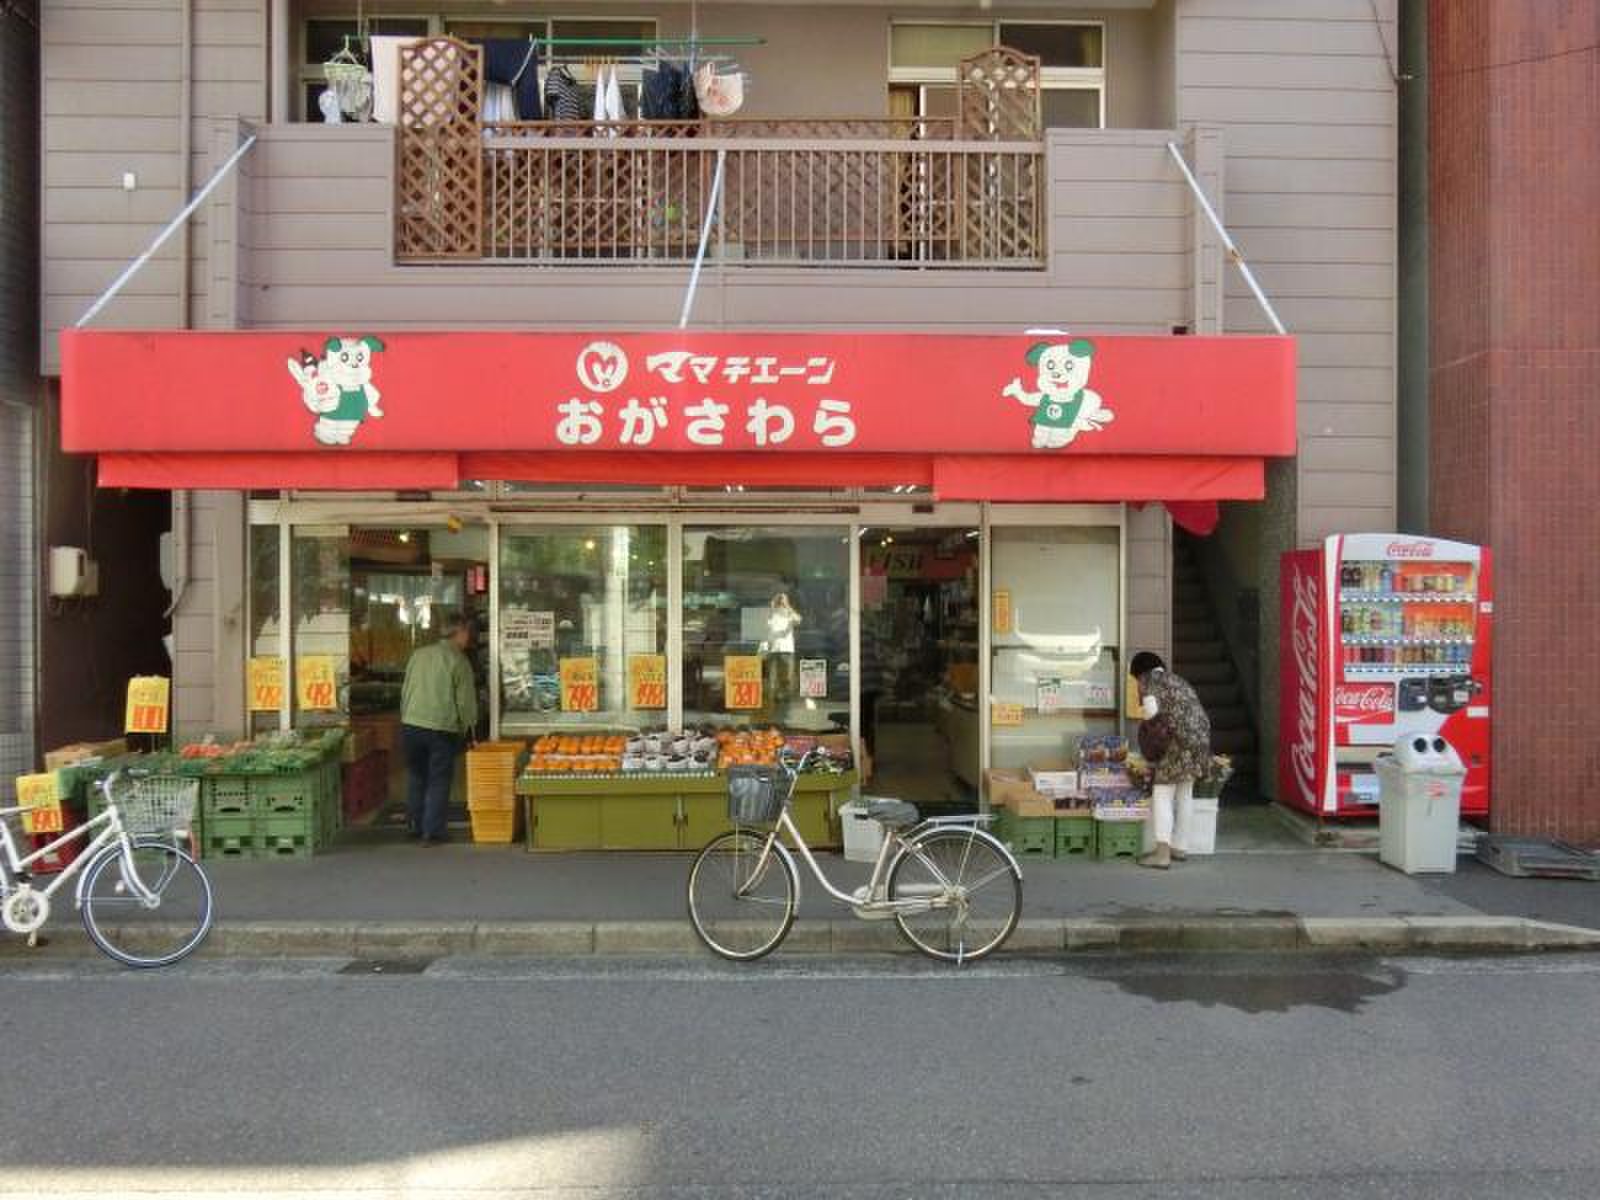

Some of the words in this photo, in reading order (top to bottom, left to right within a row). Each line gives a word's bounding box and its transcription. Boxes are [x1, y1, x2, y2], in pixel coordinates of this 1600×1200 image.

[556, 398, 857, 446] おがさわら
